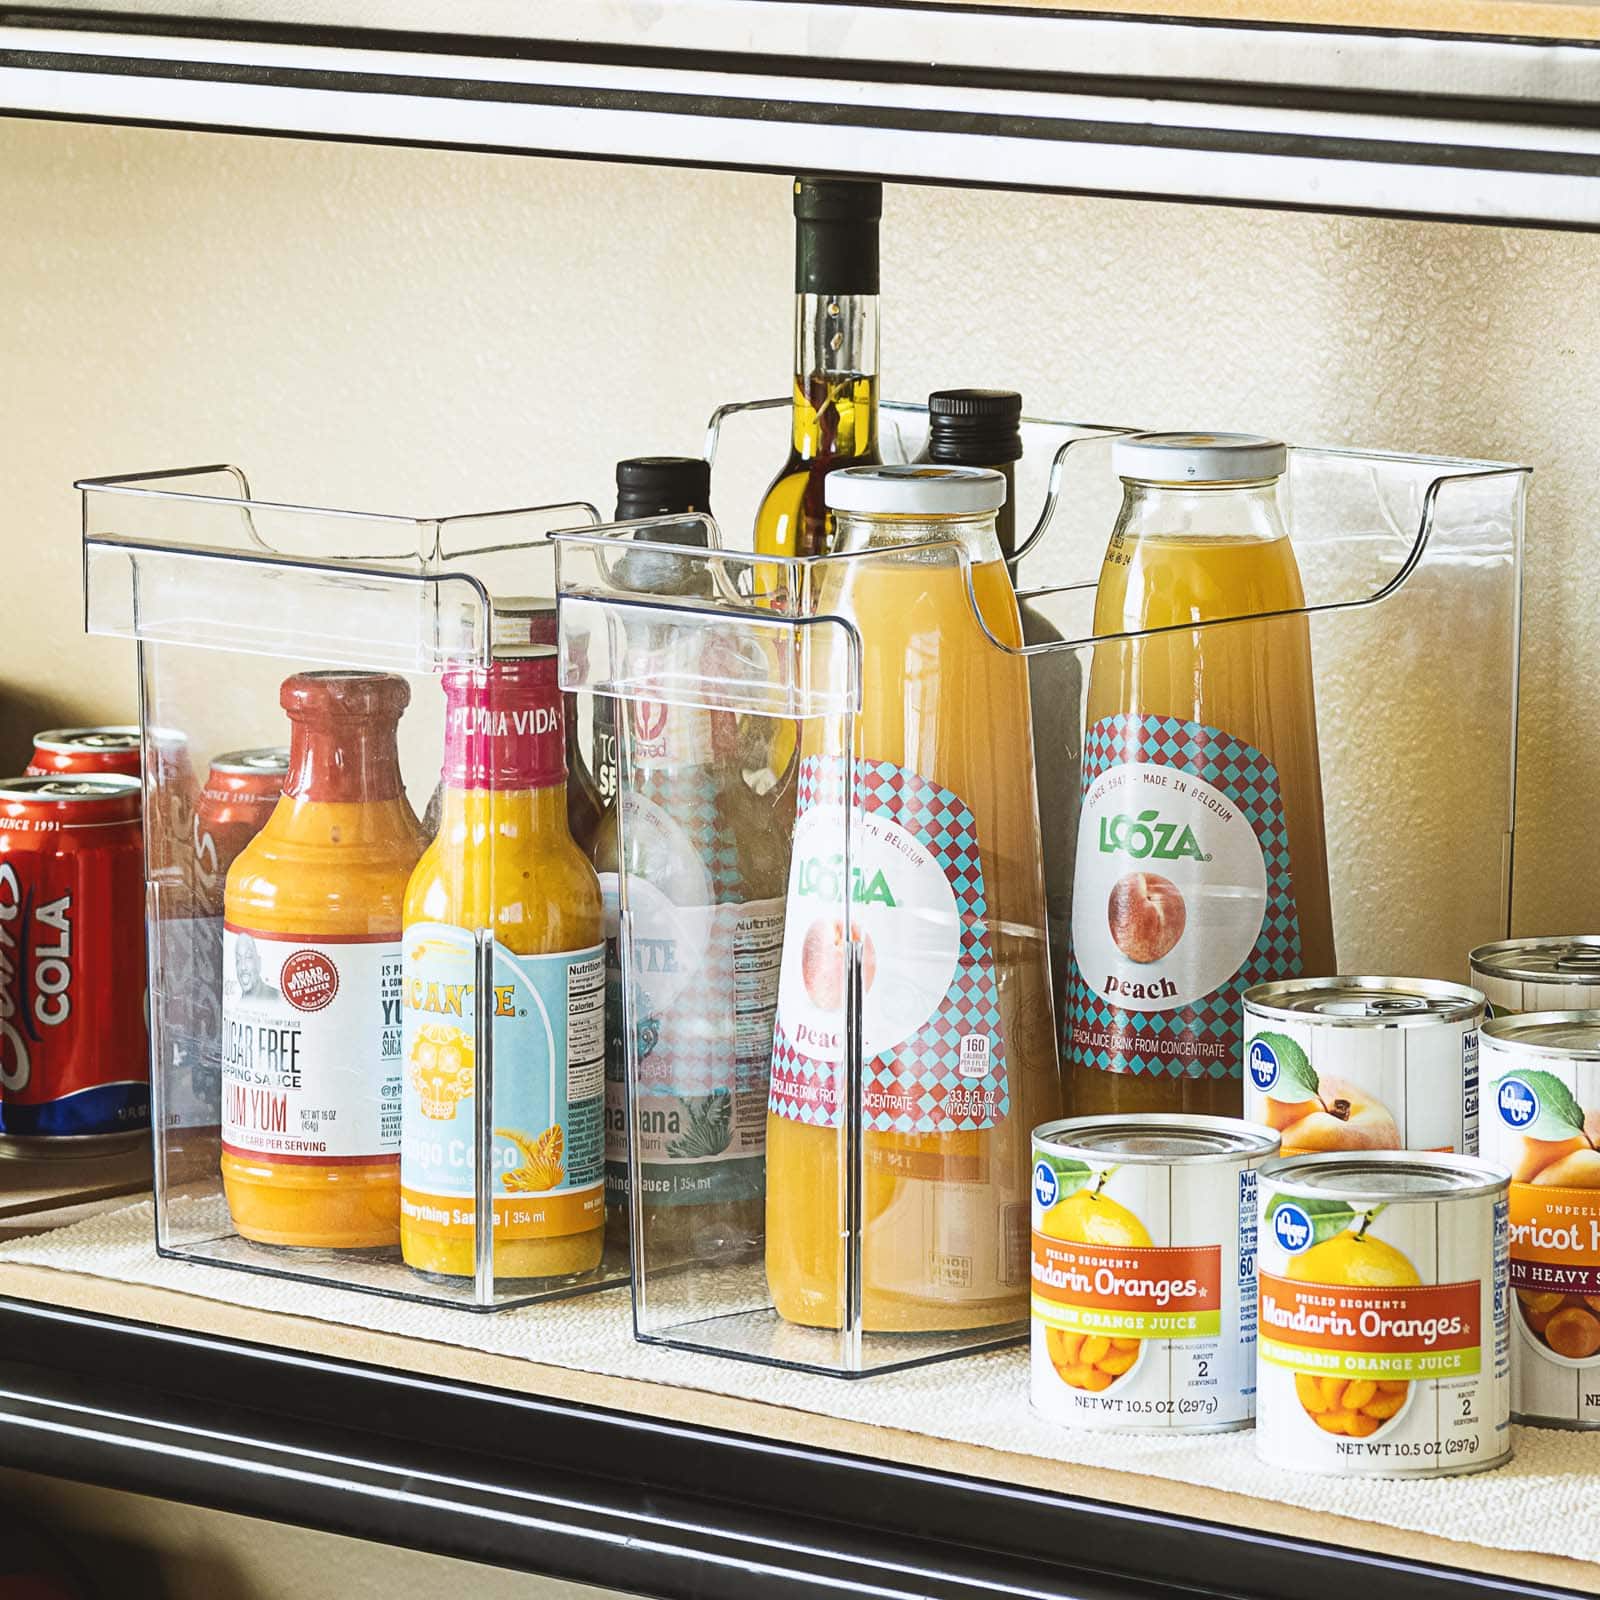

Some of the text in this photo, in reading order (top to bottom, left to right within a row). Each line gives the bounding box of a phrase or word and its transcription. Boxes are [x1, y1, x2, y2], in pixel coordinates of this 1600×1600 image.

[512, 706, 558, 736] VIDA
[1143, 773, 1168, 787] MADE
[1173, 779, 1187, 793] IN
[1191, 789, 1233, 823] BELGIUM
[34, 820, 60, 831] 1991
[884, 830, 925, 867] BELGIUM
[35, 896, 72, 1026] COLA
[292, 966, 323, 983] AWARD
[1103, 974, 1179, 999] peach
[259, 1026, 302, 1074] FREE
[966, 1039, 985, 1052] 160
[1090, 1032, 1110, 1047] JUICE
[1110, 1035, 1134, 1051] DRINK
[1134, 1037, 1160, 1053] FROM
[1160, 1040, 1225, 1058] CONCENTRATE
[949, 1089, 995, 1104] 33.8 FL OZ
[251, 1087, 287, 1133] YUM
[284, 1140, 327, 1153] SERVING
[512, 1211, 530, 1224] 354
[533, 1210, 545, 1223] ml
[1078, 1255, 1139, 1270] SEGMENTS
[1240, 1255, 1253, 1277] 60
[1511, 1264, 1526, 1279] IN
[1532, 1267, 1589, 1284] HEAVY
[1094, 1269, 1198, 1306] Oranges
[1295, 1292, 1407, 1310] PEELED SEGMENTS
[1082, 1310, 1198, 1330] ORANGE JUICE
[1262, 1294, 1357, 1337] Mandarin
[1359, 1310, 1461, 1346] Oranges
[1192, 1352, 1214, 1361] ABOUT
[1344, 1355, 1413, 1371] ORANGE
[1417, 1354, 1462, 1370] JUICE
[1197, 1360, 1209, 1378] 2
[1074, 1395, 1218, 1415] NET WT 10.5 OZ (297g)
[1462, 1399, 1472, 1416] 2
[1336, 1434, 1480, 1457] NET WT 10.5 OZ (297g)
